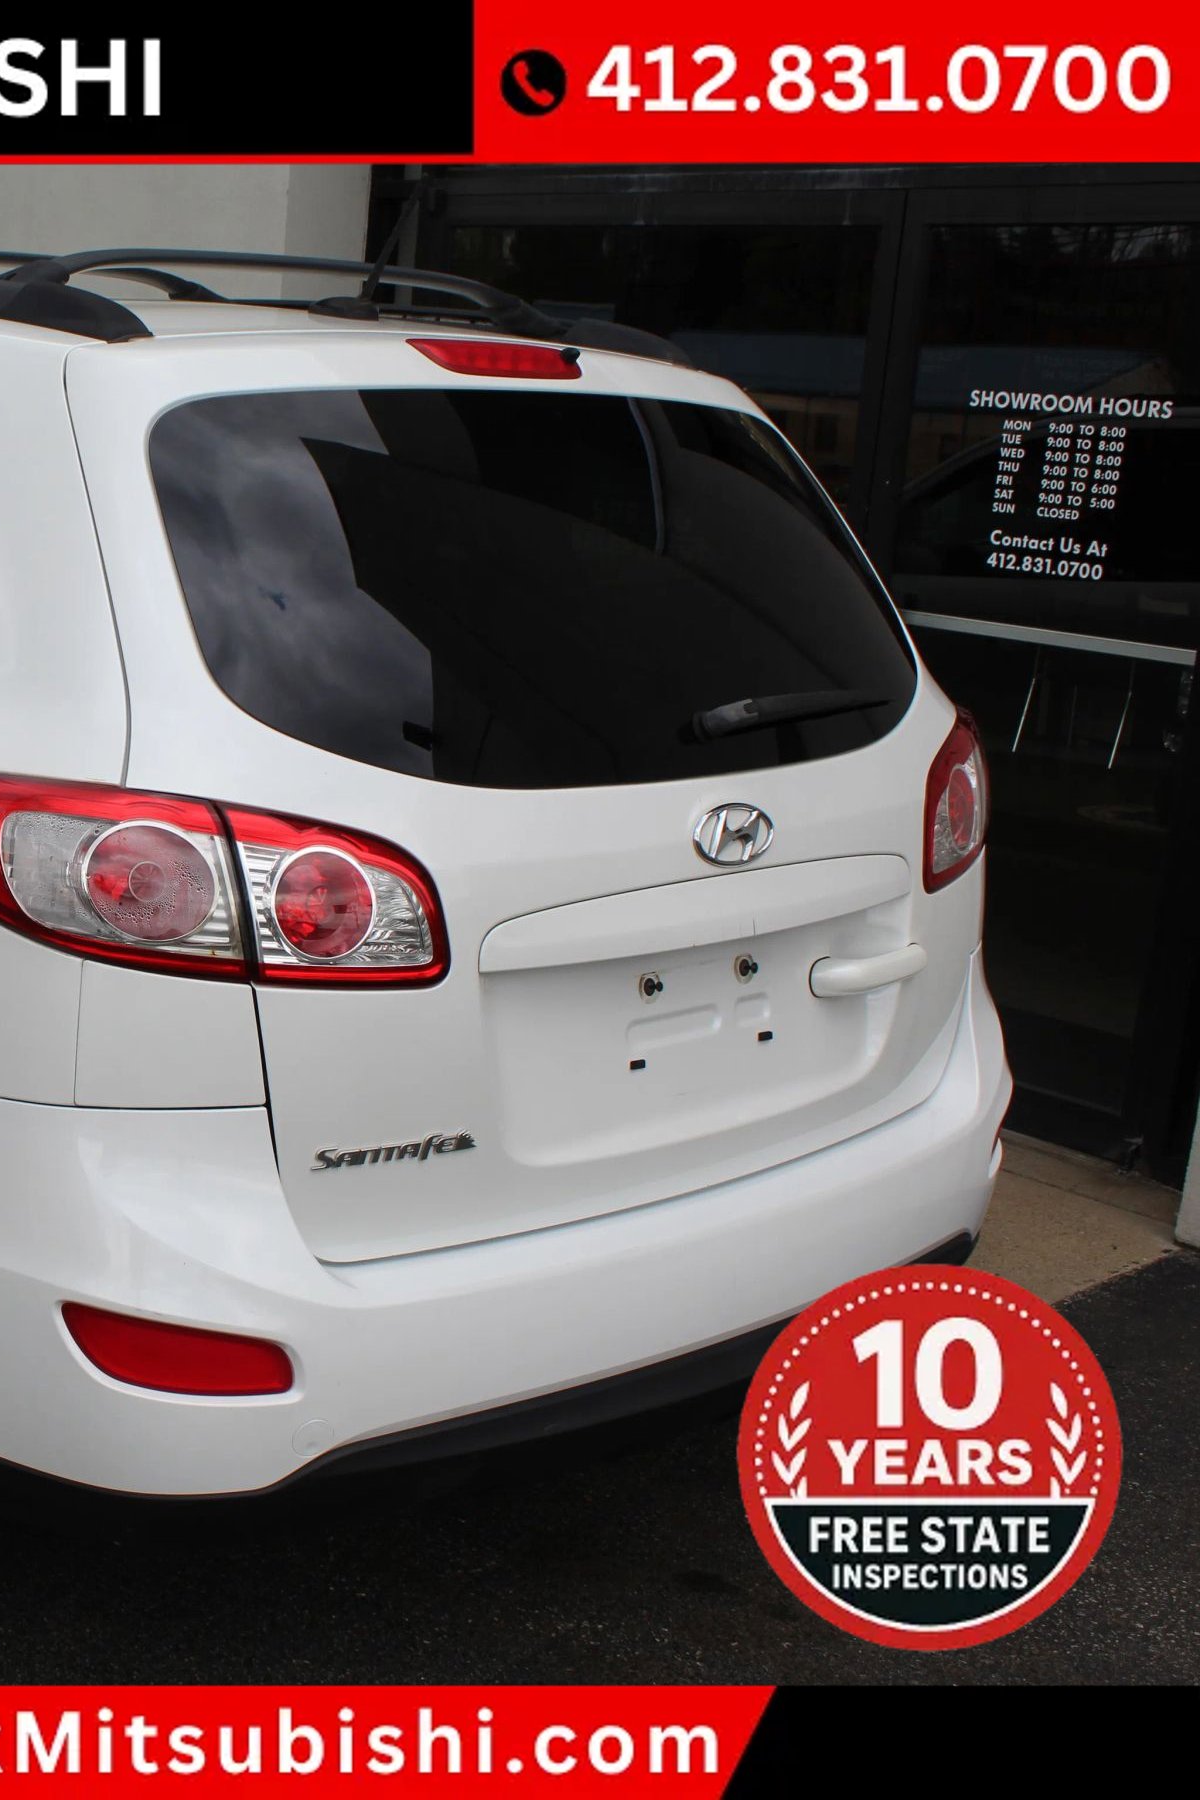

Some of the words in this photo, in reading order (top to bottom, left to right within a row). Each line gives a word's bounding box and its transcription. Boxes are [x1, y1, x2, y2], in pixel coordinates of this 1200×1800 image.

[970, 390, 1092, 413] SHOWROOM
[1100, 398, 1173, 418] HOURS
[1004, 420, 1031, 430] MON
[1049, 423, 1073, 434] 9:00
[1080, 425, 1094, 435] TO
[1101, 426, 1126, 437] 8:00
[1002, 434, 1021, 444] TUE
[1048, 437, 1070, 448] 9:00
[1077, 439, 1091, 449] TO
[1099, 441, 1124, 452] 8:00
[1001, 448, 1024, 458] WED
[1045, 451, 1069, 462] 9:00
[1076, 454, 1090, 464] TO
[1096, 455, 1121, 466] 8:00
[999, 461, 1019, 472] THU
[1043, 465, 1067, 476] 9:00
[1074, 468, 1088, 478] TO
[1094, 469, 1119, 480] 8:00
[996, 475, 1012, 485] FRI
[1041, 479, 1064, 490] 9:00
[1071, 482, 1085, 492] TO
[1092, 484, 1116, 495] 6:00
[995, 489, 1013, 499] SAT
[1039, 493, 1062, 504] 9:00
[1068, 496, 1082, 506] TO
[1090, 498, 1114, 509] 5:00
[993, 502, 1015, 513] SUN
[1037, 507, 1079, 520] CLOSED
[991, 530, 1054, 550] Contact
[1061, 537, 1080, 554] Us
[1087, 541, 1107, 556] At
[987, 552, 1103, 580] 412.831.0700
